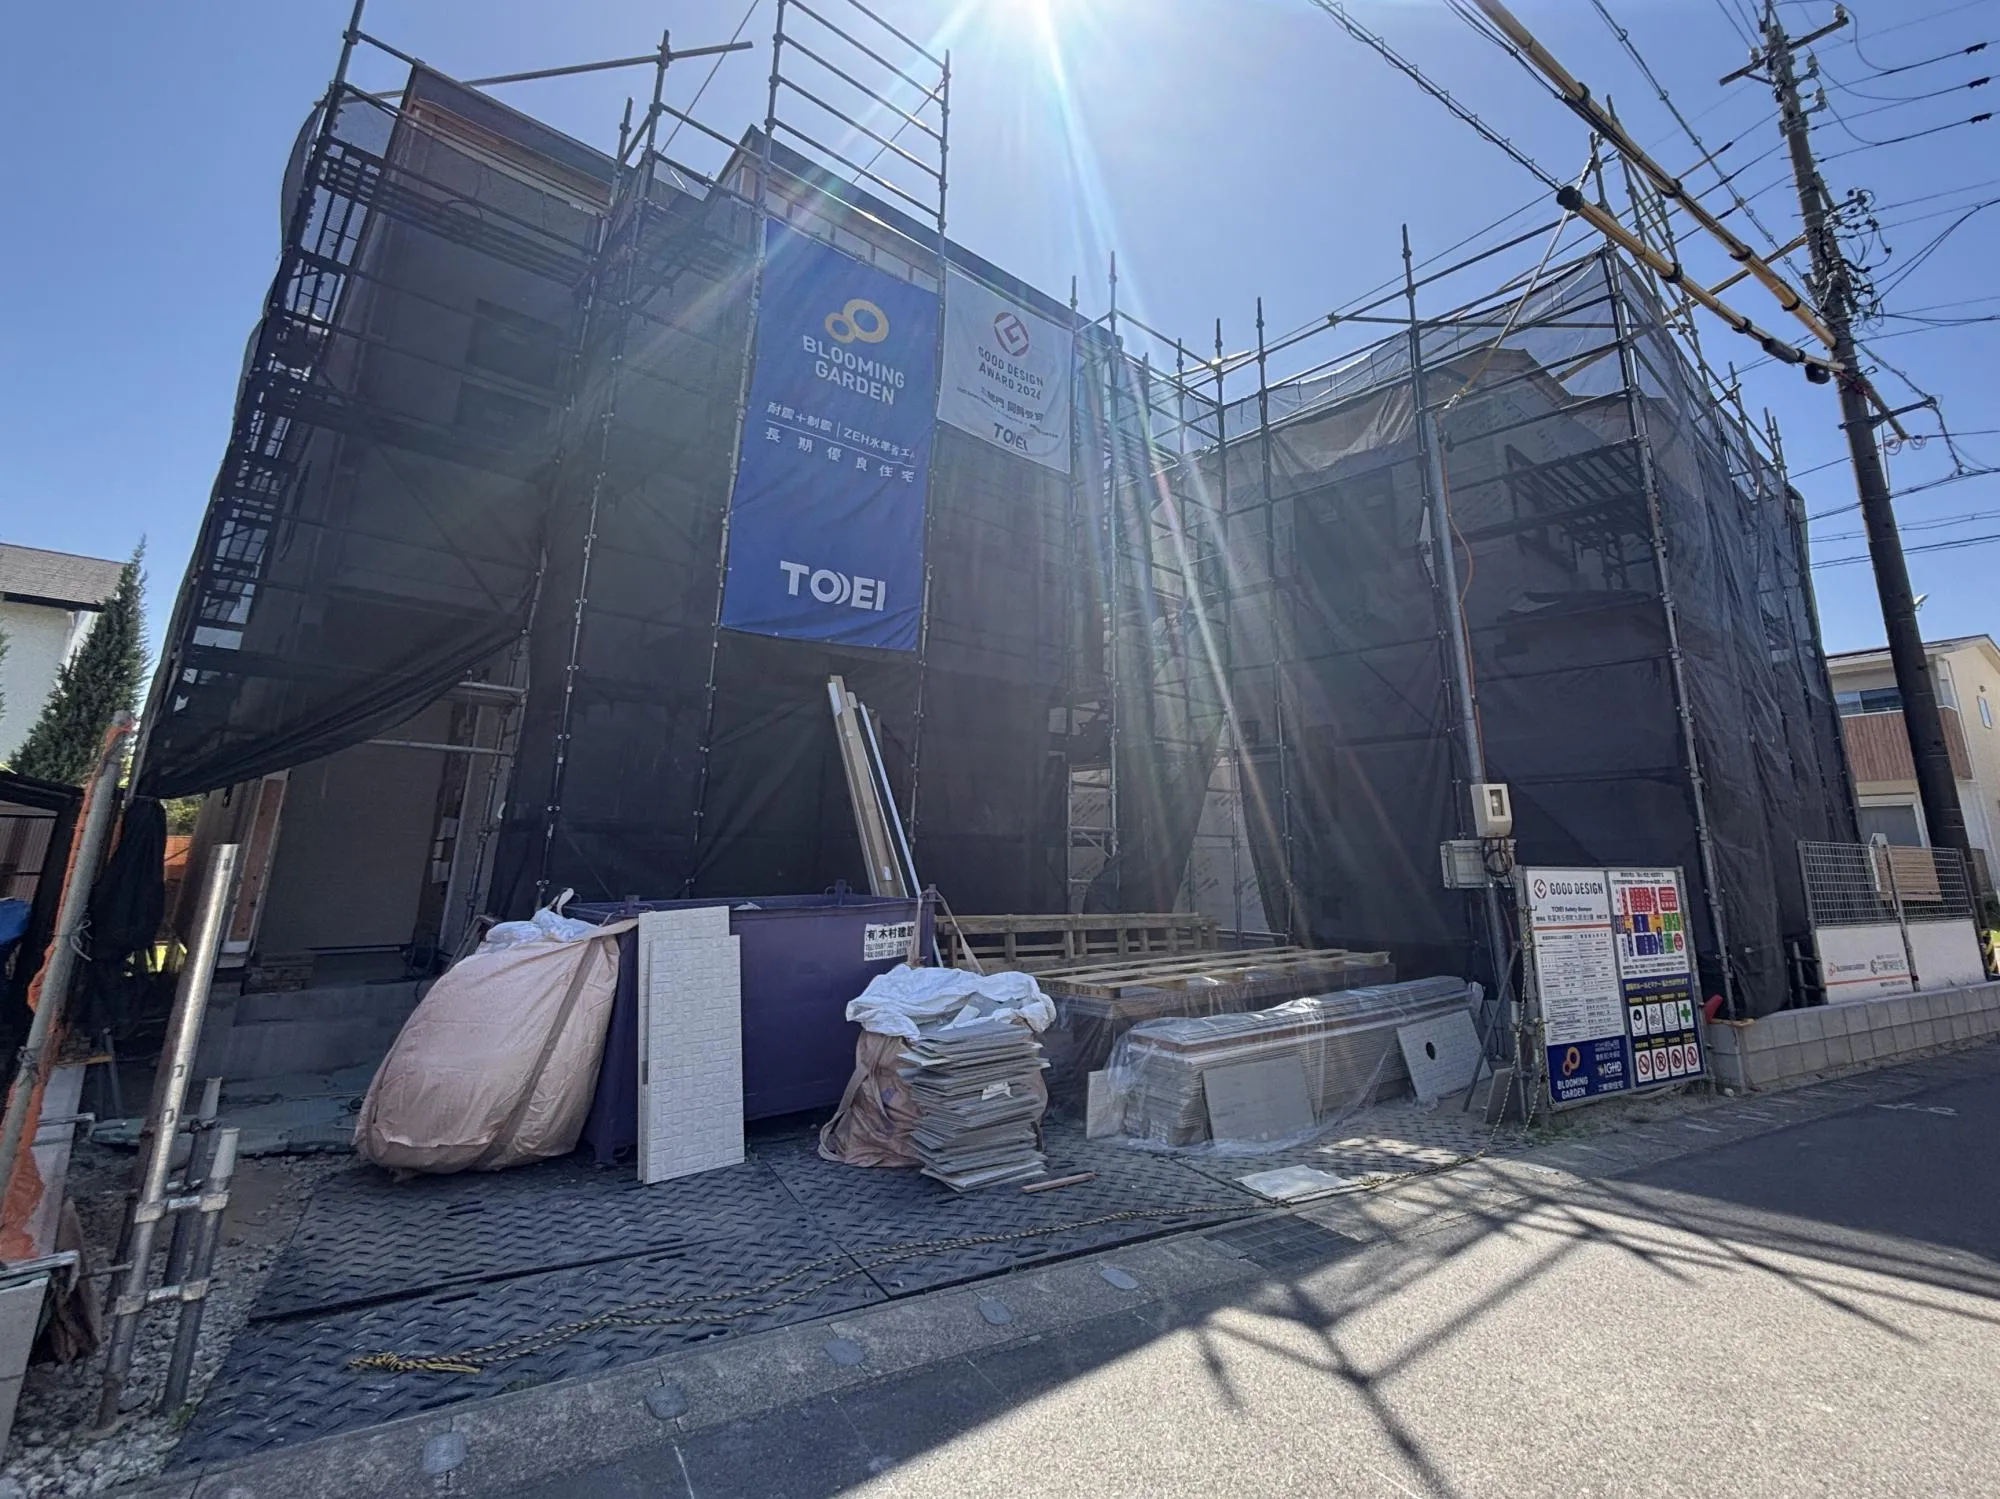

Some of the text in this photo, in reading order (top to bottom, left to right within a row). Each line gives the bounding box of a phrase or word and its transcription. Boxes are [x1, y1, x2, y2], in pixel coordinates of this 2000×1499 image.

[801, 335, 905, 388] BLOOMING
[978, 346, 1043, 387] GOOD DESIGN
[979, 362, 1014, 390] AWARD
[1017, 383, 1041, 400] 2024
[814, 361, 895, 406] GARDEN
[779, 560, 887, 612] TOEI
[1549, 882, 1573, 896] GOOD
[1575, 881, 1604, 895] DESIGN
[1557, 1076, 1589, 1090] BLOOMING
[1561, 1087, 1586, 1100] GARDEN
